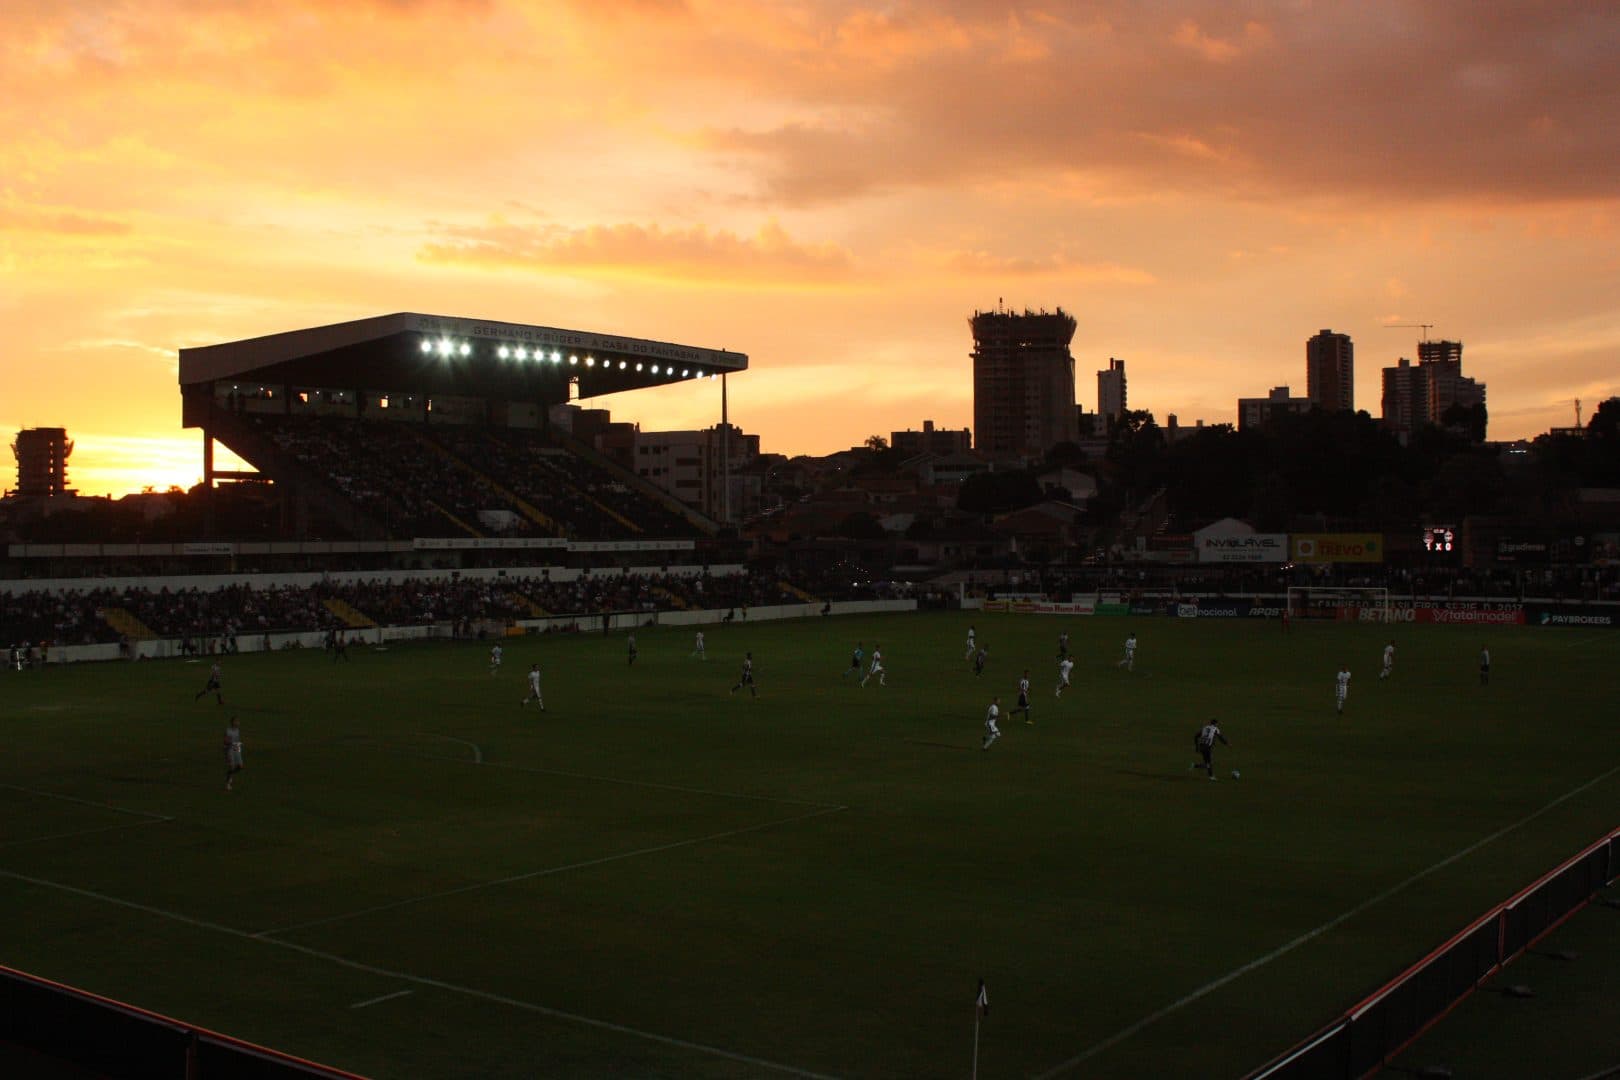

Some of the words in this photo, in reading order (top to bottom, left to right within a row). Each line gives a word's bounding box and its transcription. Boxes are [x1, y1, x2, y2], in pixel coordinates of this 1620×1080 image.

[633, 344, 648, 353] DO
[1319, 544, 1362, 556] TREVO
[1359, 608, 1416, 622] BETANO
[1552, 615, 1611, 625] PAYBROKERS
